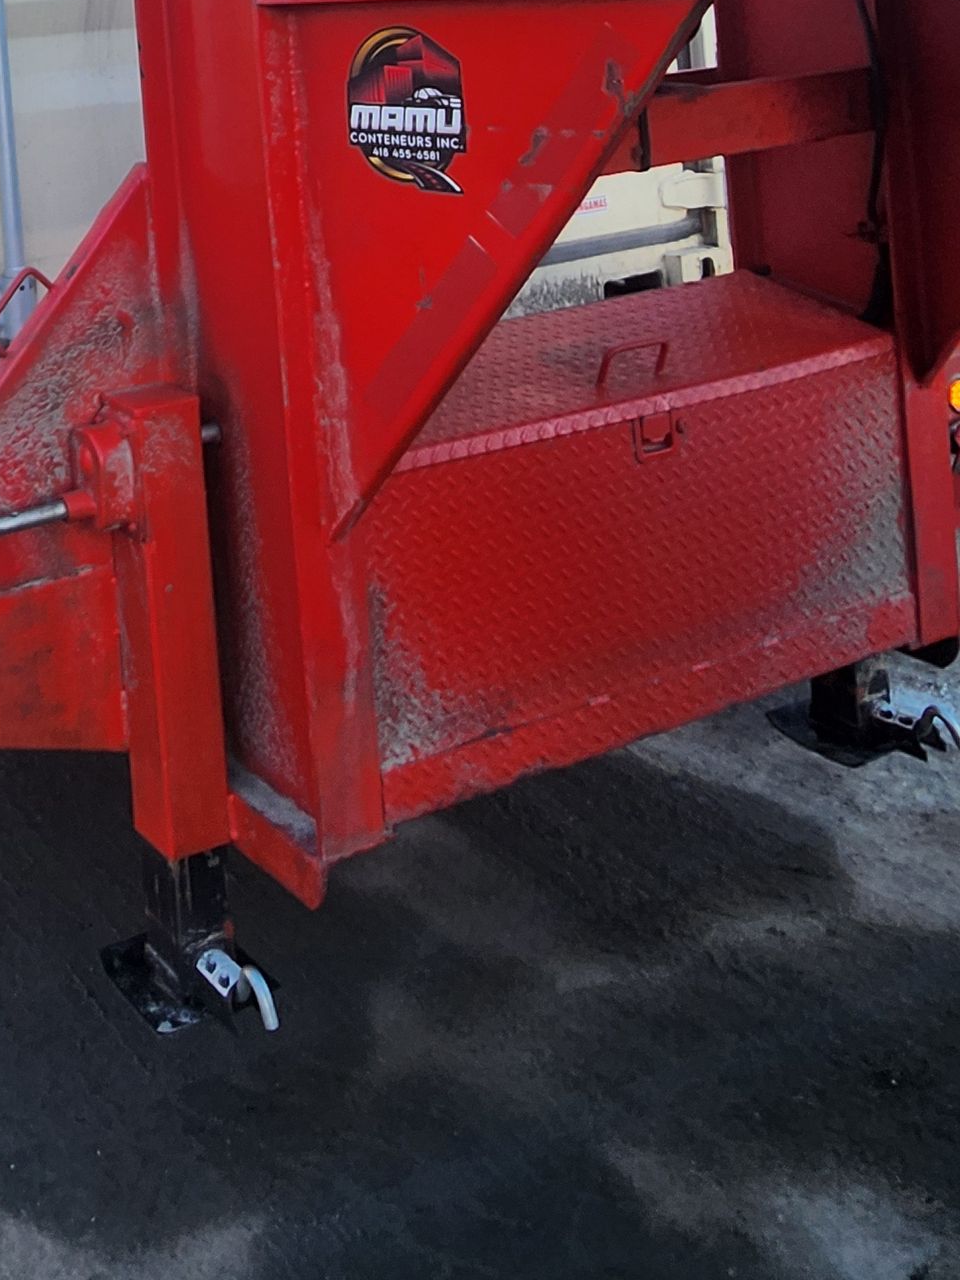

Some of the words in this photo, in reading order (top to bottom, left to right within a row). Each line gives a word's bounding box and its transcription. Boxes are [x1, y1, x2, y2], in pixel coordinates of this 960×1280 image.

[350, 132, 432, 148] CONTENEURS
[436, 136, 464, 151] INC.
[372, 146, 389, 158] 418
[392, 147, 440, 161] 455-6581
